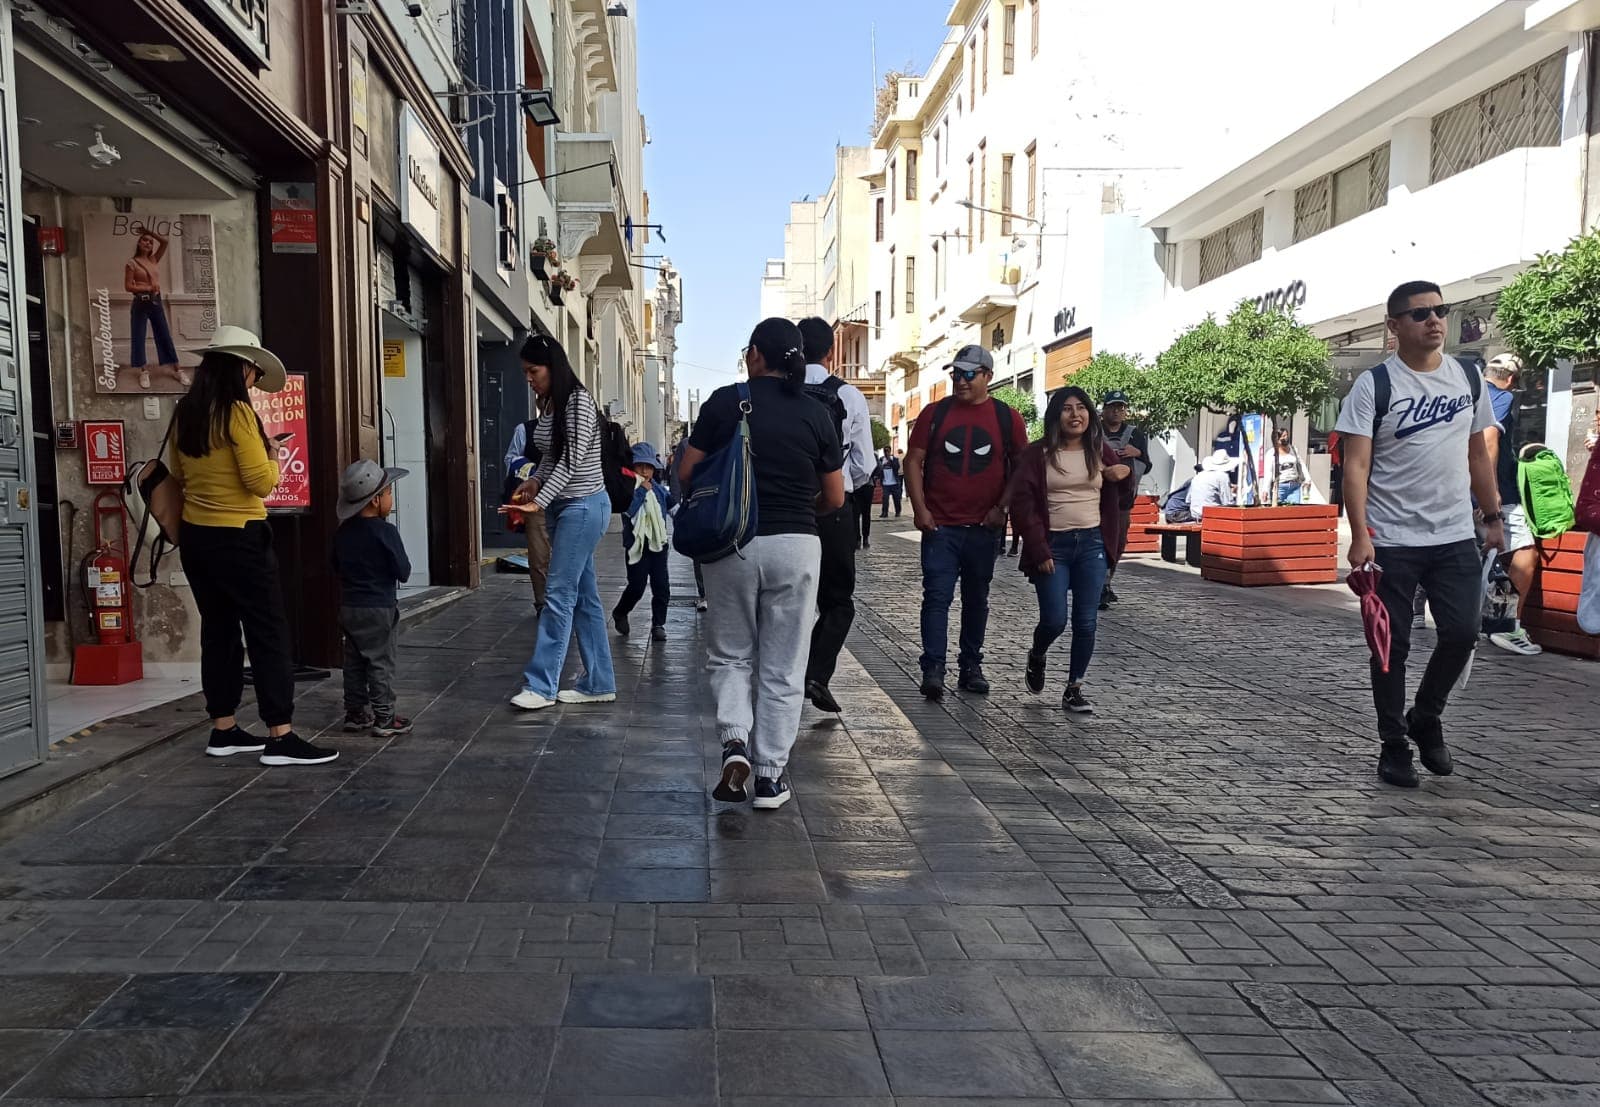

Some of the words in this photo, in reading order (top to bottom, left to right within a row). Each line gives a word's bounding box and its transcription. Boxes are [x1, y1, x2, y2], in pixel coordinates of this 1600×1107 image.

[113, 215, 184, 237] Bellas
[92, 288, 120, 390] Empoderadas
[252, 393, 303, 412] DACIÓN
[1389, 394, 1471, 431] Hilfiger
